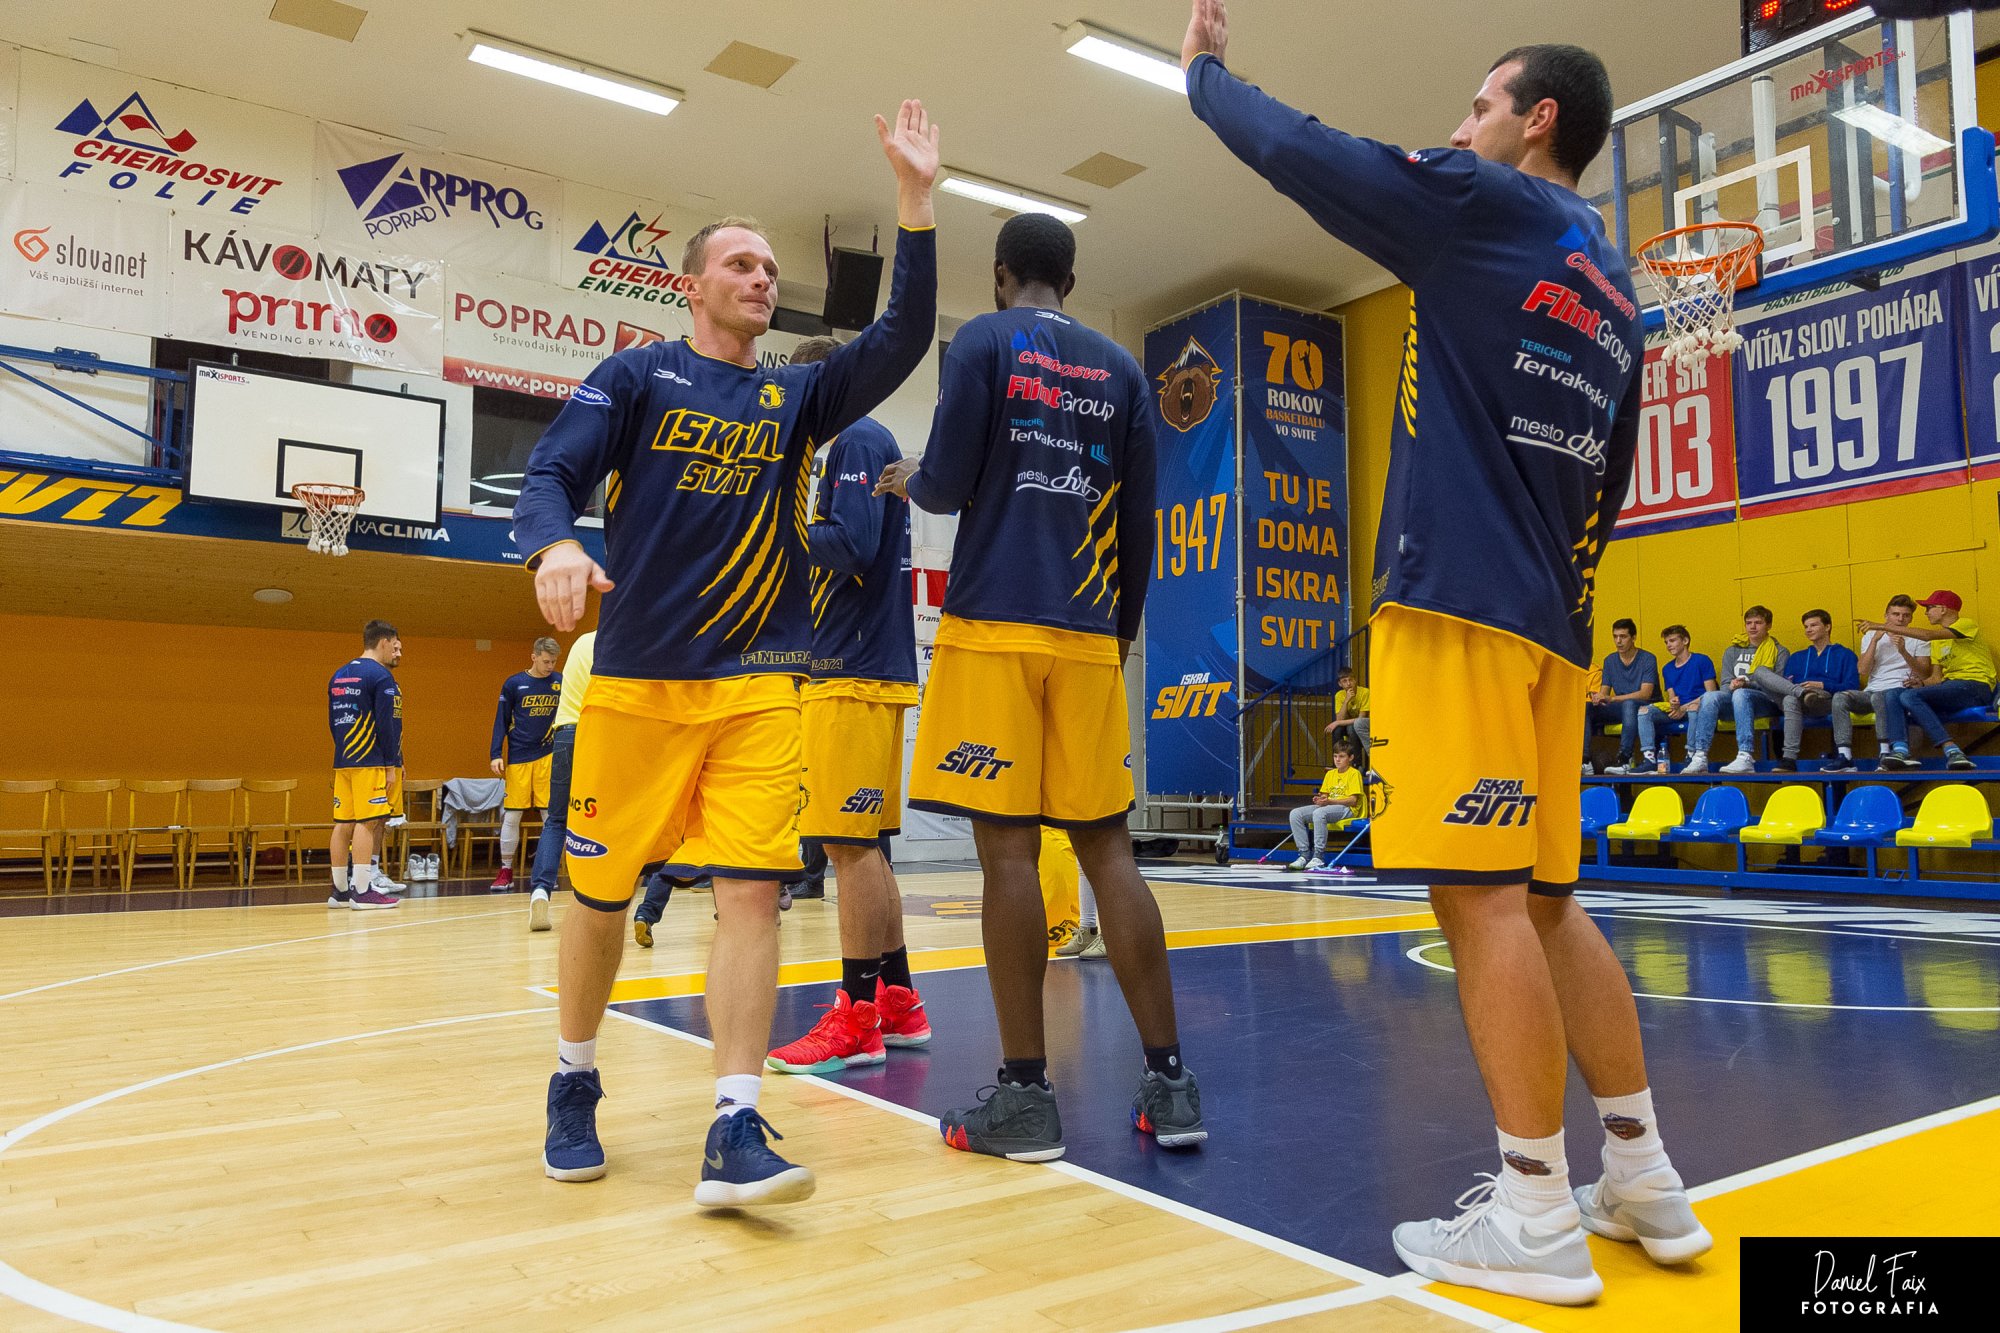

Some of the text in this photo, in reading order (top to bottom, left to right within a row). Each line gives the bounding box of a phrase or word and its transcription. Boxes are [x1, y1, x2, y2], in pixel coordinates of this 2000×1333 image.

[73, 140, 283, 196] CHEMOSVIT
[59, 161, 261, 215] FOLIE
[364, 205, 437, 239] POPRAD
[56, 235, 147, 279] slovanet
[29, 269, 144, 297] Váš najbližší internet
[578, 276, 689, 308] ENERGOC
[588, 258, 683, 292] CHEMO
[1565, 251, 1636, 321] CHEMOSVIT
[455, 293, 606, 347] POPRAD
[1743, 289, 1943, 371] VÍŤAZ SLOV. POHÁRA
[242, 329, 302, 345] VENDING
[308, 337, 323, 346] BY
[493, 332, 605, 361] Spravodajský portál
[1520, 338, 1572, 364] TERICHEM
[1018, 350, 1111, 381] CHEMOSVIT
[1263, 330, 1324, 391] 70
[1513, 351, 1608, 409] Tervakoski
[1267, 387, 1323, 415] ROKOV
[1765, 342, 1923, 485] 1997
[1265, 408, 1326, 429] BASKETBALU
[1275, 423, 1317, 442] VO SVITE
[1510, 415, 1564, 442] mesto
[676, 460, 761, 495] SVIT
[1017, 470, 1048, 485] mesto
[1263, 470, 1331, 514] TU JE
[1155, 492, 1227, 580] 1947
[1258, 518, 1339, 558] DOMA
[1256, 566, 1340, 604] ISKRA
[917, 614, 939, 623] Trans
[1260, 615, 1322, 649] SVIT
[1180, 672, 1211, 685] ISKRA
[1151, 681, 1233, 719] SVIT
[935, 749, 1014, 780] SVIT
[956, 741, 997, 758] ISKRA
[1473, 777, 1524, 795] ISKRA
[1441, 793, 1538, 827] SVIT
